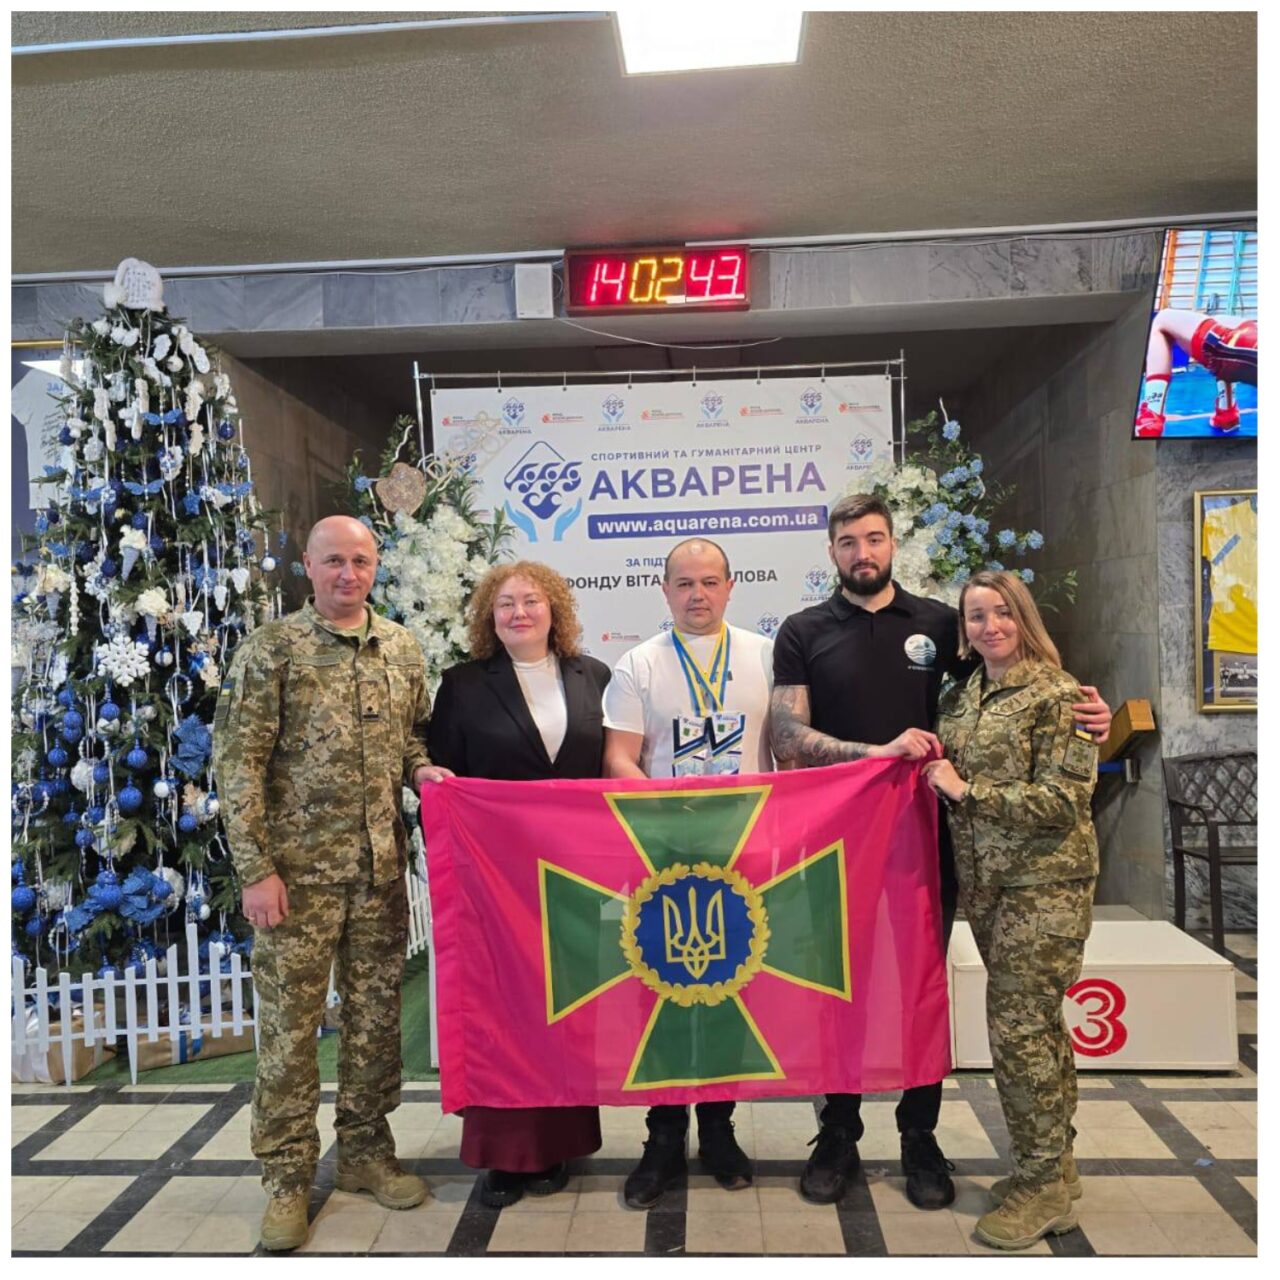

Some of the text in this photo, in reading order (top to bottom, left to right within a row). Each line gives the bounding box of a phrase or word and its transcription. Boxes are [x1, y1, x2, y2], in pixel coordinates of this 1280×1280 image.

[590, 256, 742, 302] 14 02 43
[591, 444, 822, 461] СПОРТИВНИЙ ТА ГУМАНІТАРНИЙ ЦЕНТР
[588, 461, 826, 501] АКВАРЕНА
[596, 511, 819, 535] www.aquarena.com.ua
[626, 558, 640, 568] ЗА
[626, 574, 663, 588] ВІТА
[734, 569, 778, 583] ЛОВА
[1065, 978, 1127, 1058] 3
